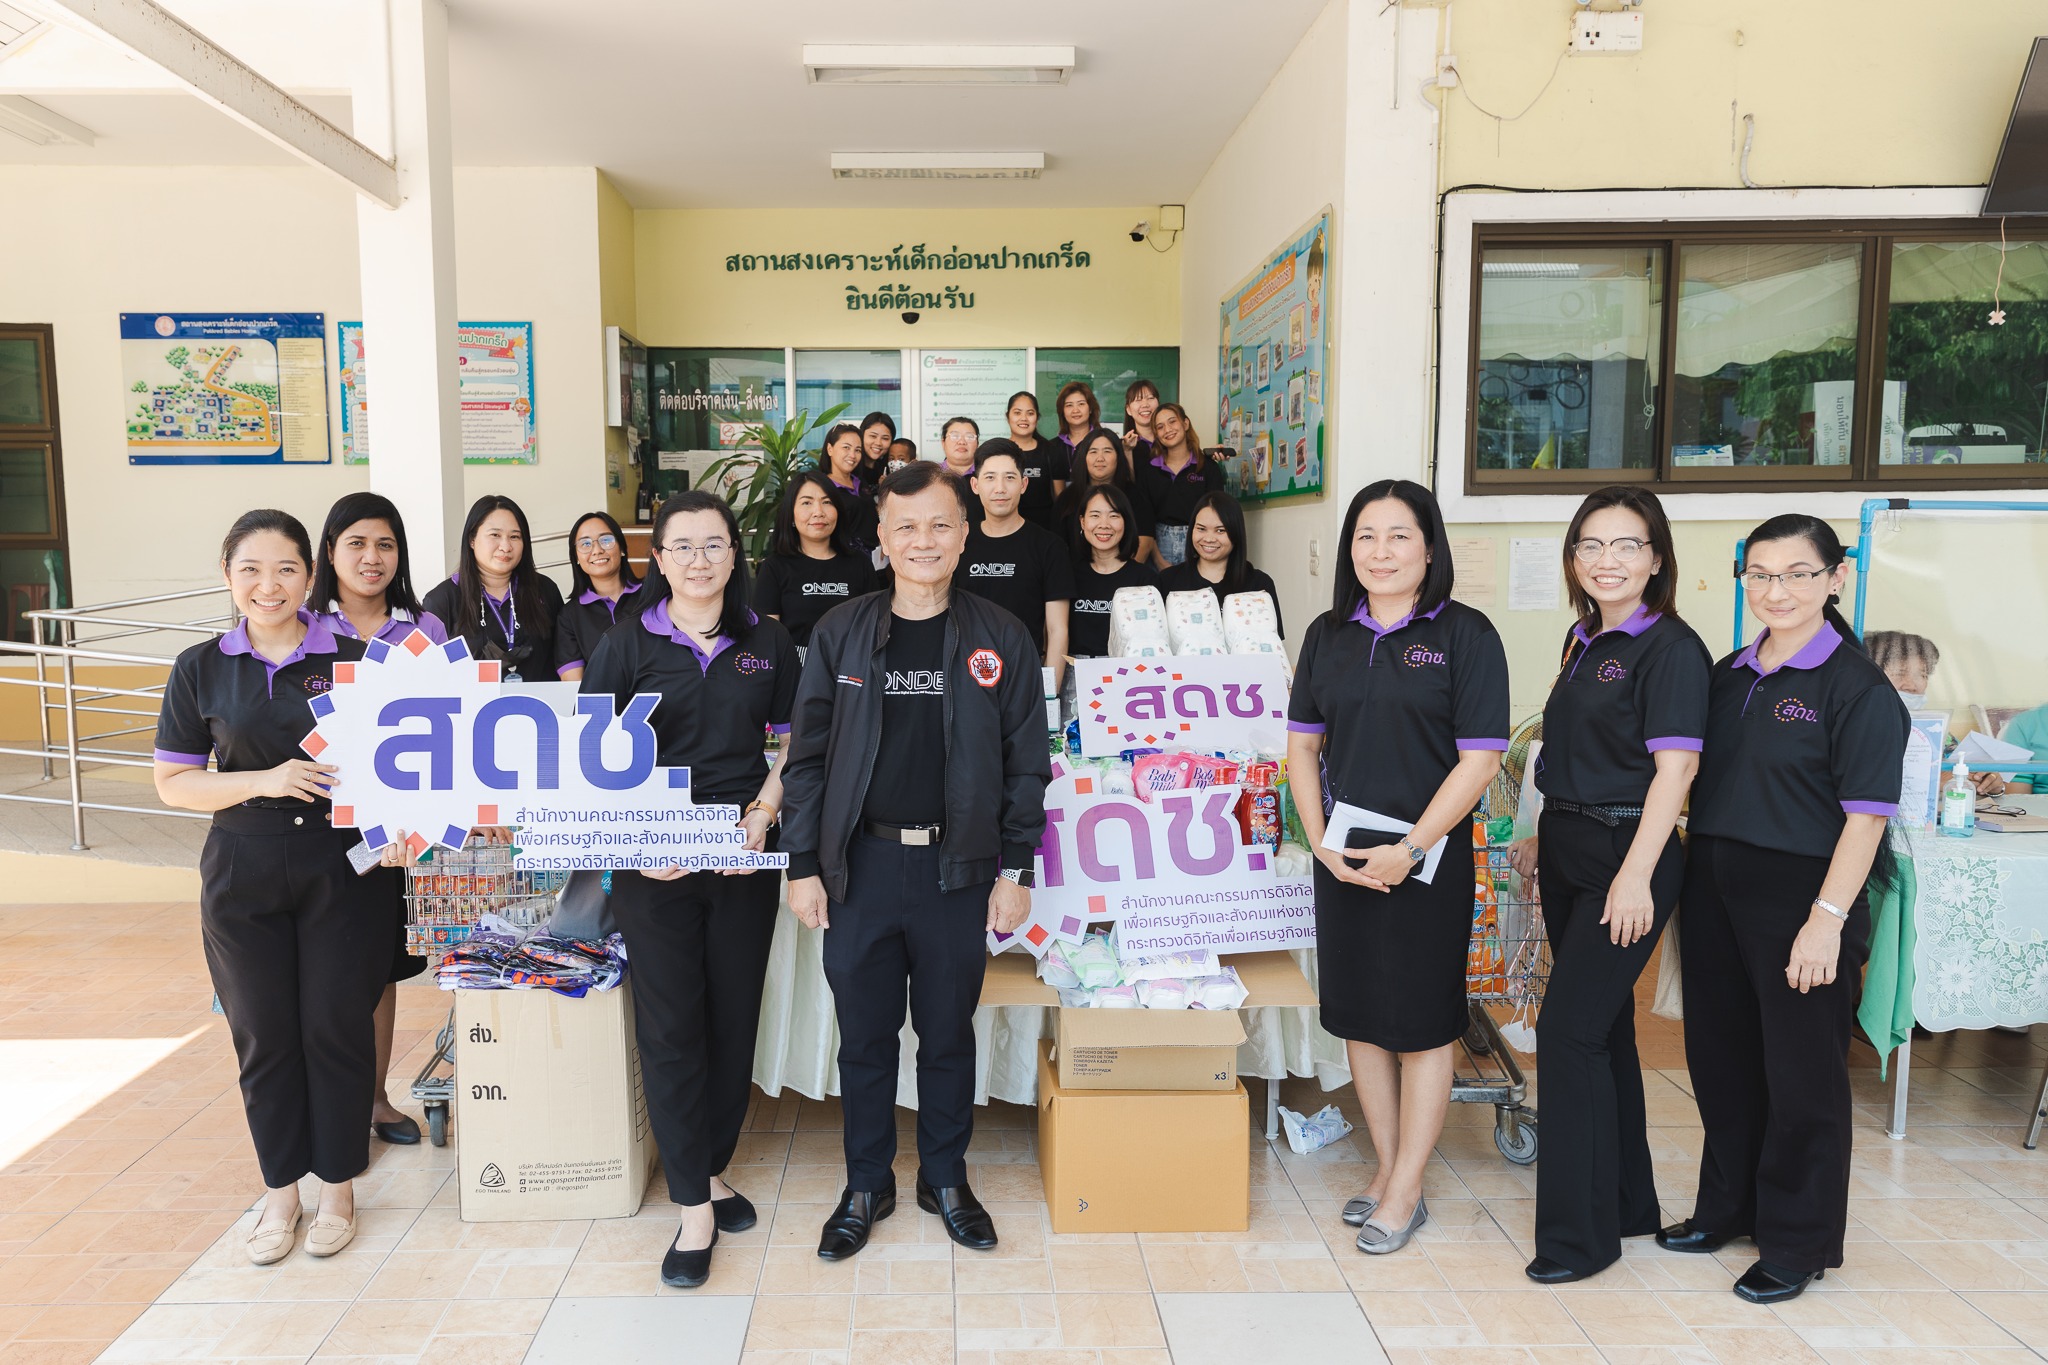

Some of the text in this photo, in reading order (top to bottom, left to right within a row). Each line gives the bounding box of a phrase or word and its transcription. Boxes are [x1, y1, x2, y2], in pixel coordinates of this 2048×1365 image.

[725, 241, 1091, 272] สถานสงเคราะห์เด็กอ่อนปากเกร็ด
[845, 284, 975, 311] ยินดีต้อนรับ
[458, 332, 508, 347] นปากเกร็ด
[969, 562, 1016, 575] ONDE
[802, 582, 849, 593] ONDE
[1075, 600, 1113, 611] OND
[741, 658, 773, 669] สดช.
[1411, 651, 1446, 665] สดช.
[1125, 684, 1283, 720] สดช.
[1782, 705, 1819, 722] สดช.
[374, 695, 688, 790] สดช.
[1148, 768, 1177, 782] Babi
[516, 806, 738, 823] สำนักงานคณะกรรมการดิจิทัล
[516, 826, 745, 849] เพื่อเศรษฐกิจและสังคมแห่งชาติ
[516, 849, 788, 870] กระทรวงดิจิทัลเพื่อเศรษฐกิจและสังคม
[1121, 883, 1314, 911] สำนักงานคณะกรรมการดิจิทัล
[469, 1023, 498, 1043] ส่ง.
[1214, 1072, 1227, 1080] x3
[471, 1085, 508, 1100] จาก.
[528, 1173, 623, 1186] www.egosportthailand.com
